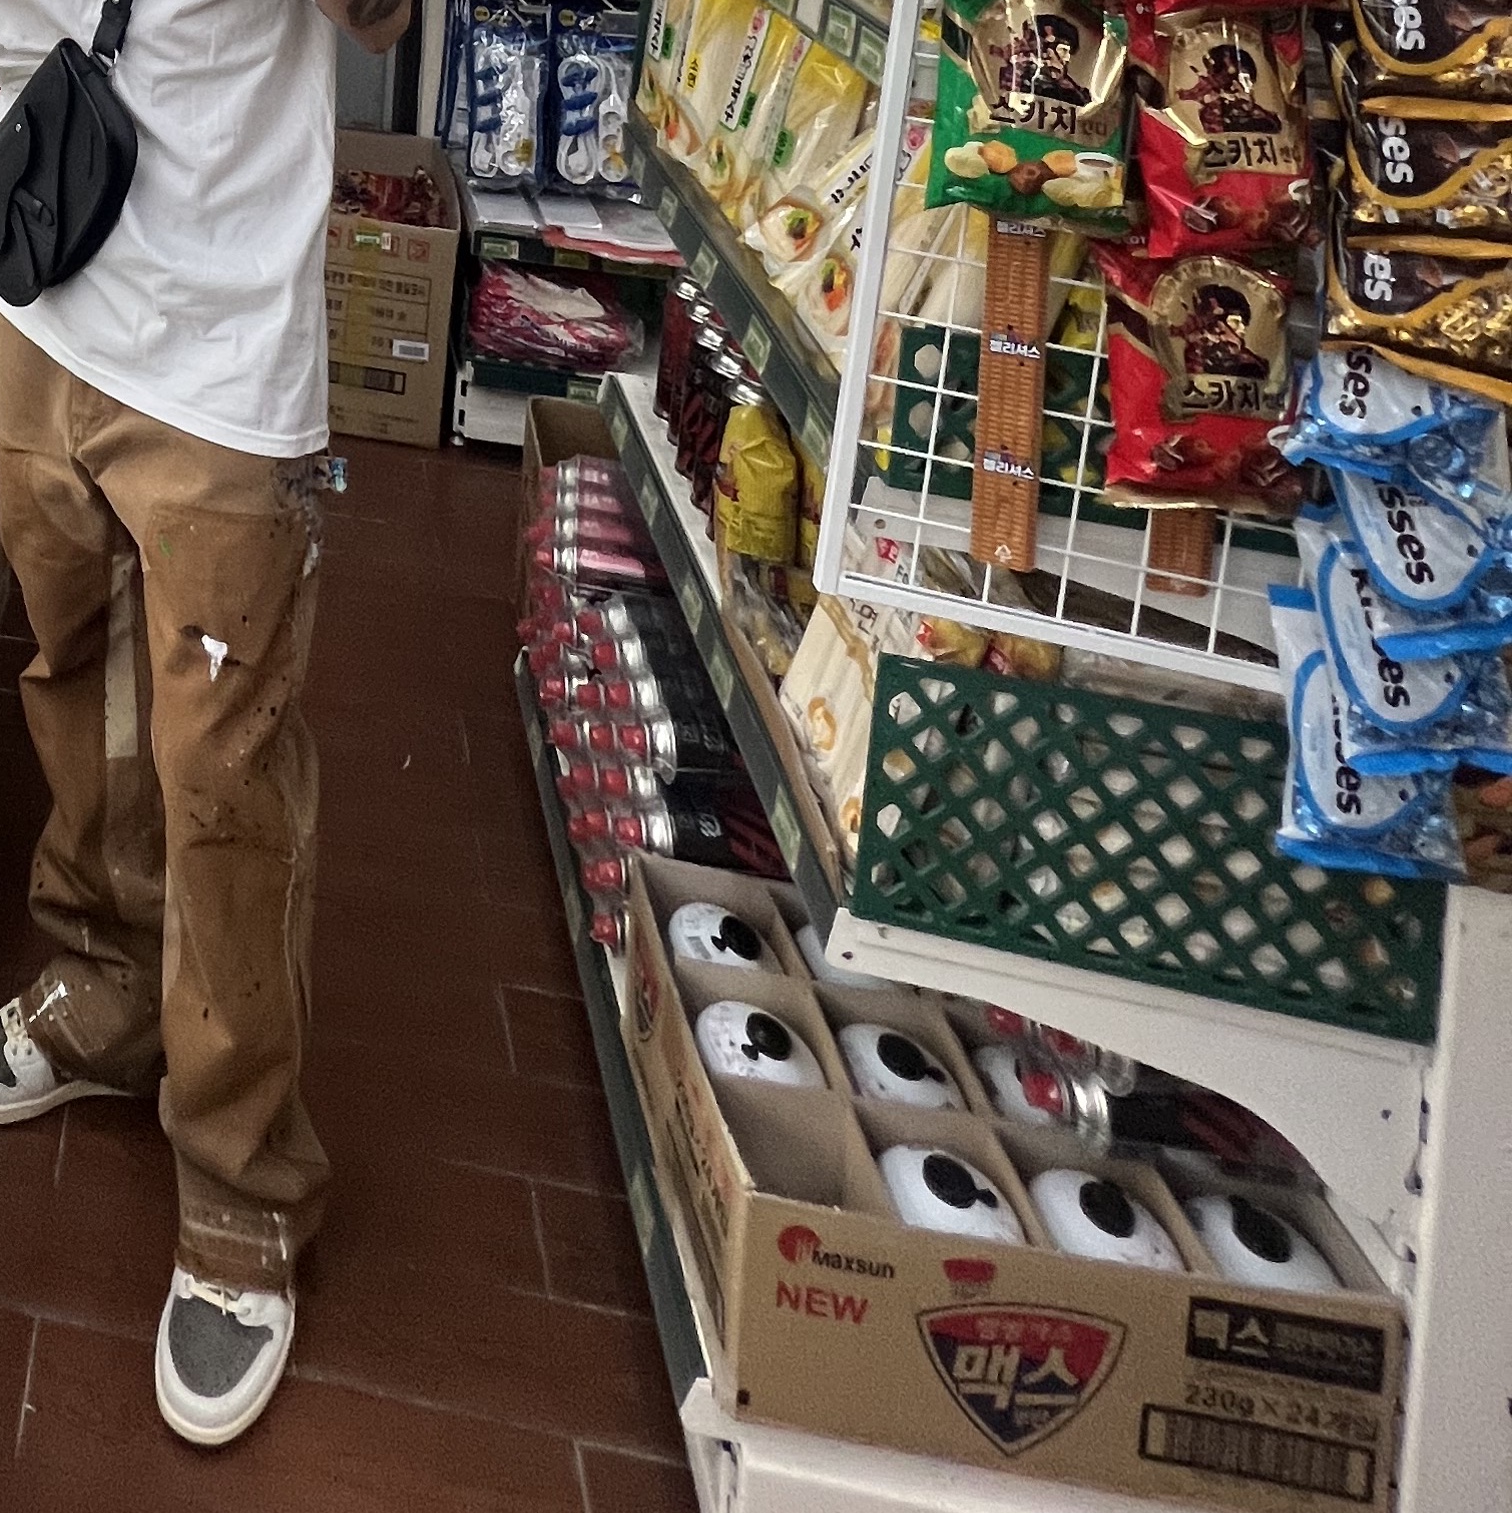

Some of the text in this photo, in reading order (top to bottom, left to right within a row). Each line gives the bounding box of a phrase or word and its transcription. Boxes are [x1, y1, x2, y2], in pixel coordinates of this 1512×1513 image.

[989, 94, 1077, 136] 스카치
[1202, 133, 1279, 170] 스카치
[1182, 377, 1262, 412] 스카치
[812, 1248, 896, 1280] Maxsun
[775, 1278, 869, 1326] NEW
[950, 1343, 1081, 1410] 맥스
